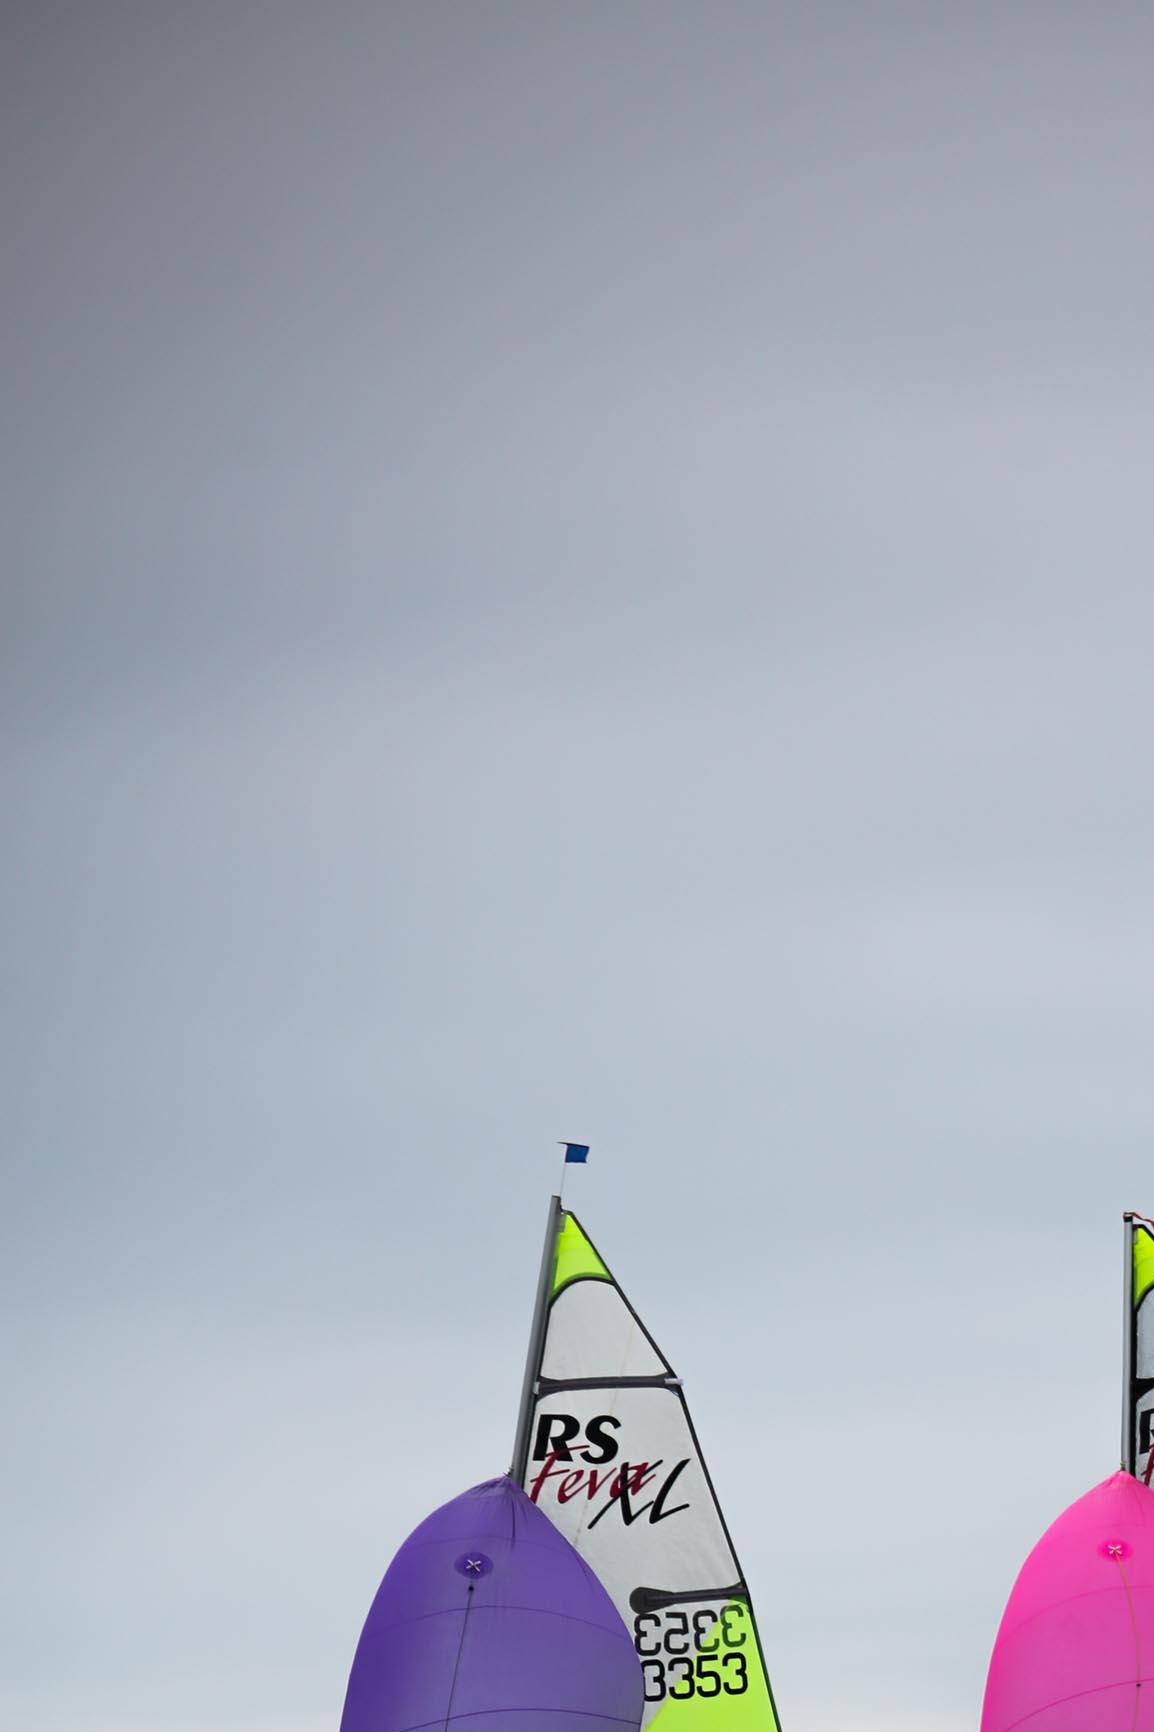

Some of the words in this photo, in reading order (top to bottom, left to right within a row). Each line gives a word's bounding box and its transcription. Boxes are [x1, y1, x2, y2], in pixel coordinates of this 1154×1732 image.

[532, 1413, 622, 1464] RS
[587, 1458, 691, 1530] XL
[641, 1651, 749, 1702] 3353
